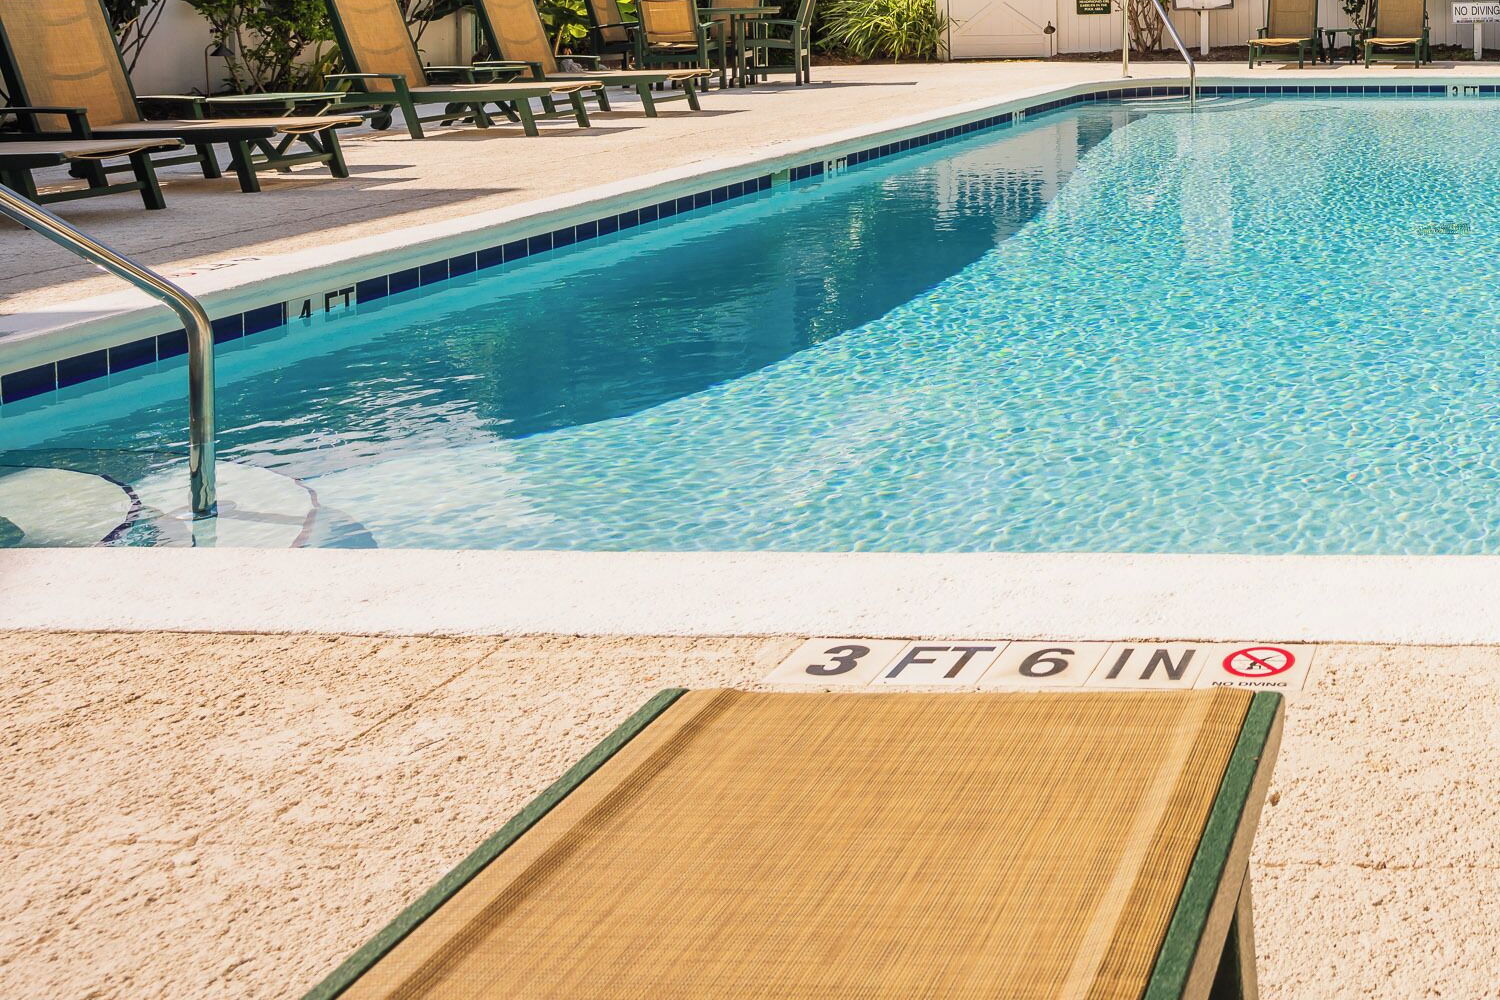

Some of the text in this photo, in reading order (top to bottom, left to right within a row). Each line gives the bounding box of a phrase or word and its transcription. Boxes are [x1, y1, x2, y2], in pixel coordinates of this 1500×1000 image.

[1454, 5, 1500, 16] NO DIVING
[298, 286, 355, 320] 4 FT
[804, 644, 1197, 681] 3 FT 6 IN
